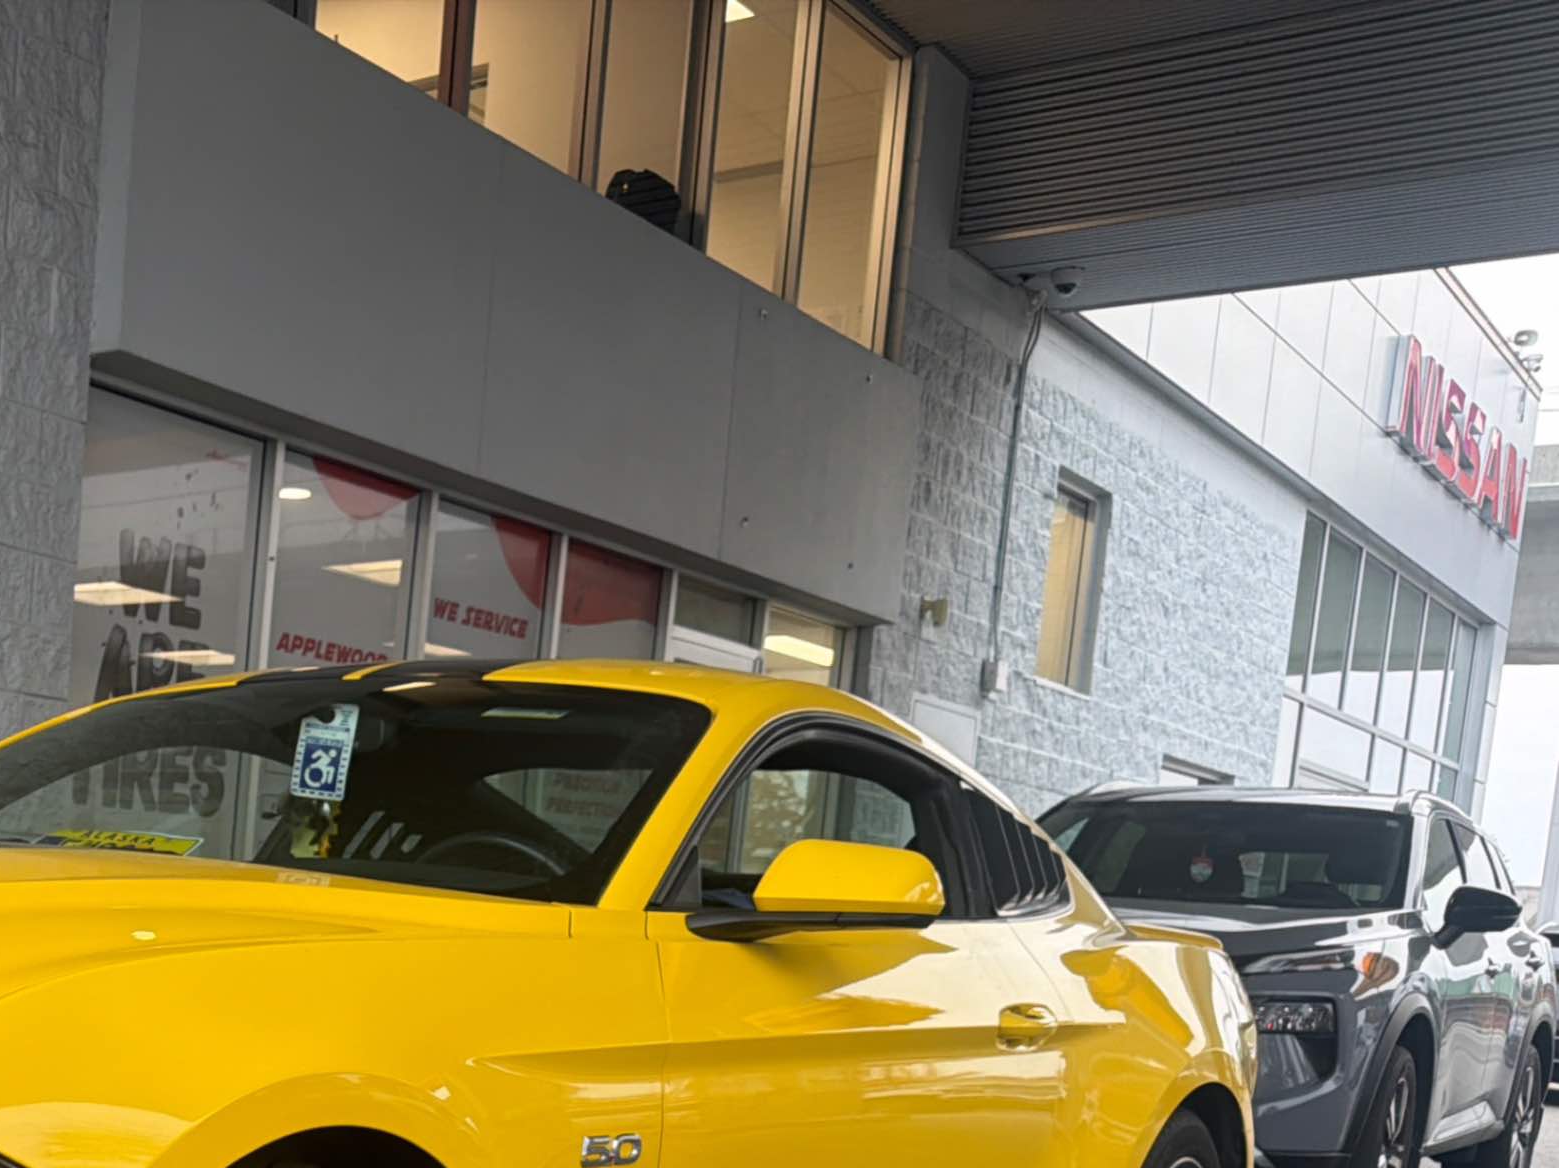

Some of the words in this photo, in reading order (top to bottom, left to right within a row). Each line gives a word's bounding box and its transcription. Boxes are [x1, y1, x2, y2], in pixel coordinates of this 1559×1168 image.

[1401, 335, 1528, 540] NISSAN
[120, 529, 206, 630] WE
[433, 598, 460, 623] WE
[461, 607, 529, 639] SERVICE
